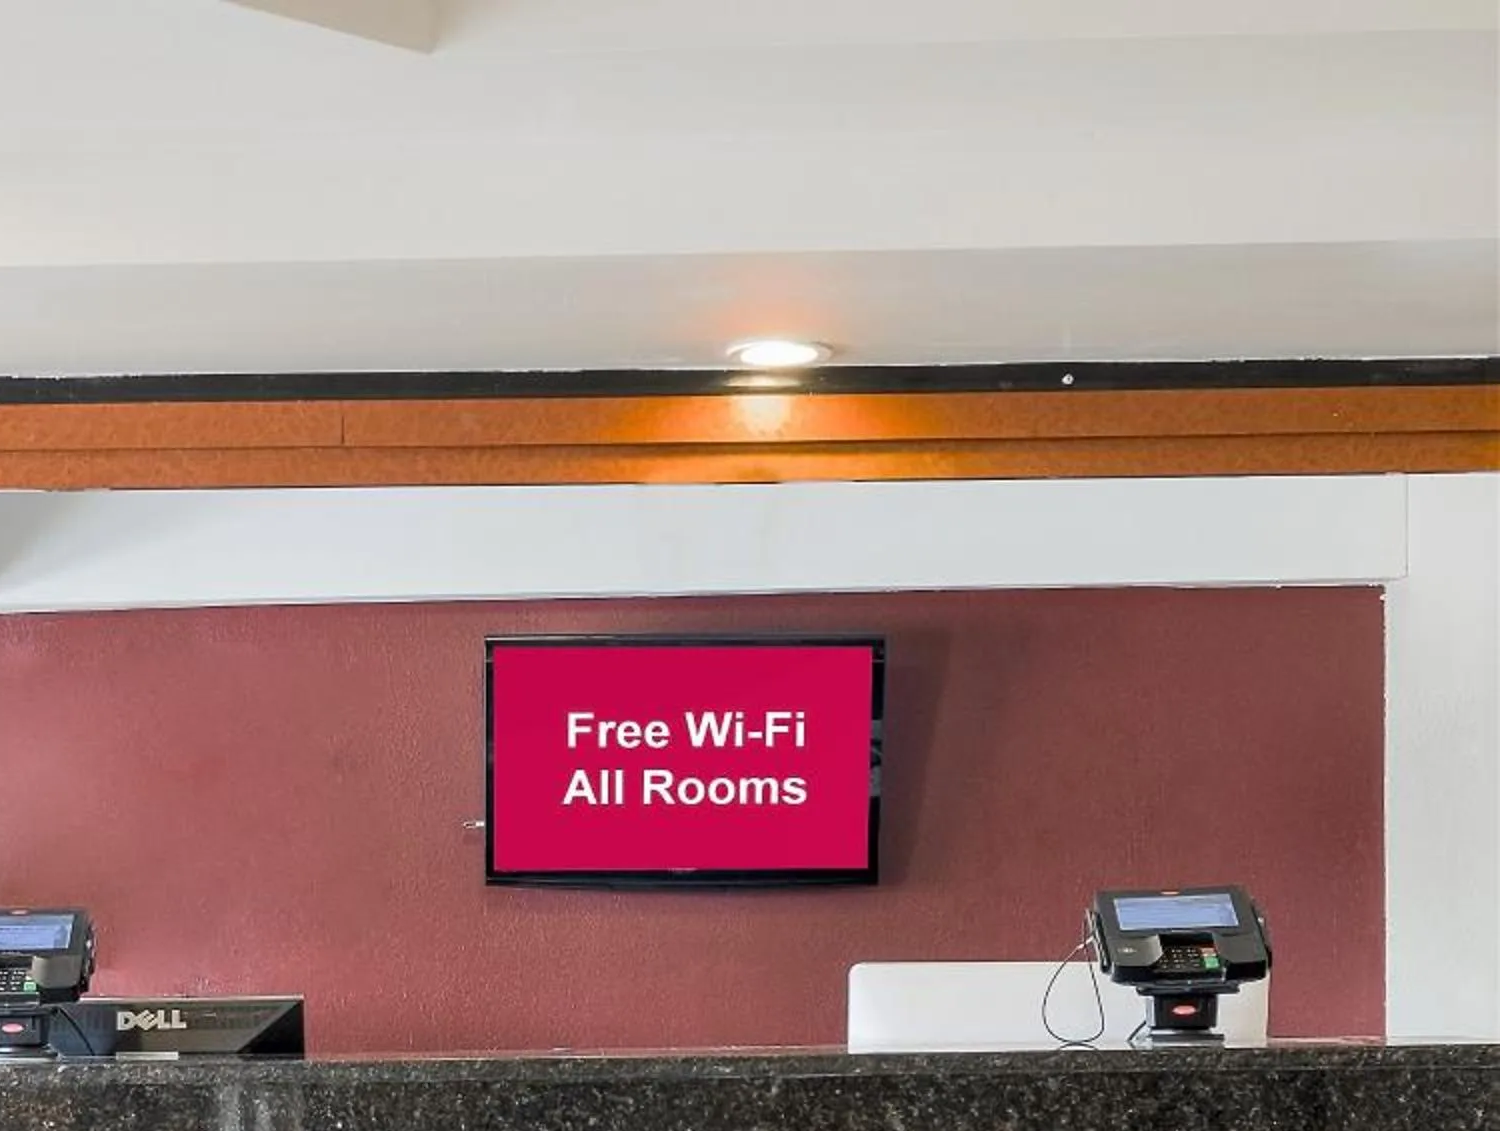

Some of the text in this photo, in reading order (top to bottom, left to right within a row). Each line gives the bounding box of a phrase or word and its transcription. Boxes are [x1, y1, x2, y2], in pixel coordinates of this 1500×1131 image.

[567, 711, 805, 748] Free Wi-Fi
[562, 769, 807, 805] All Rooms
[117, 1009, 187, 1030] DELL
